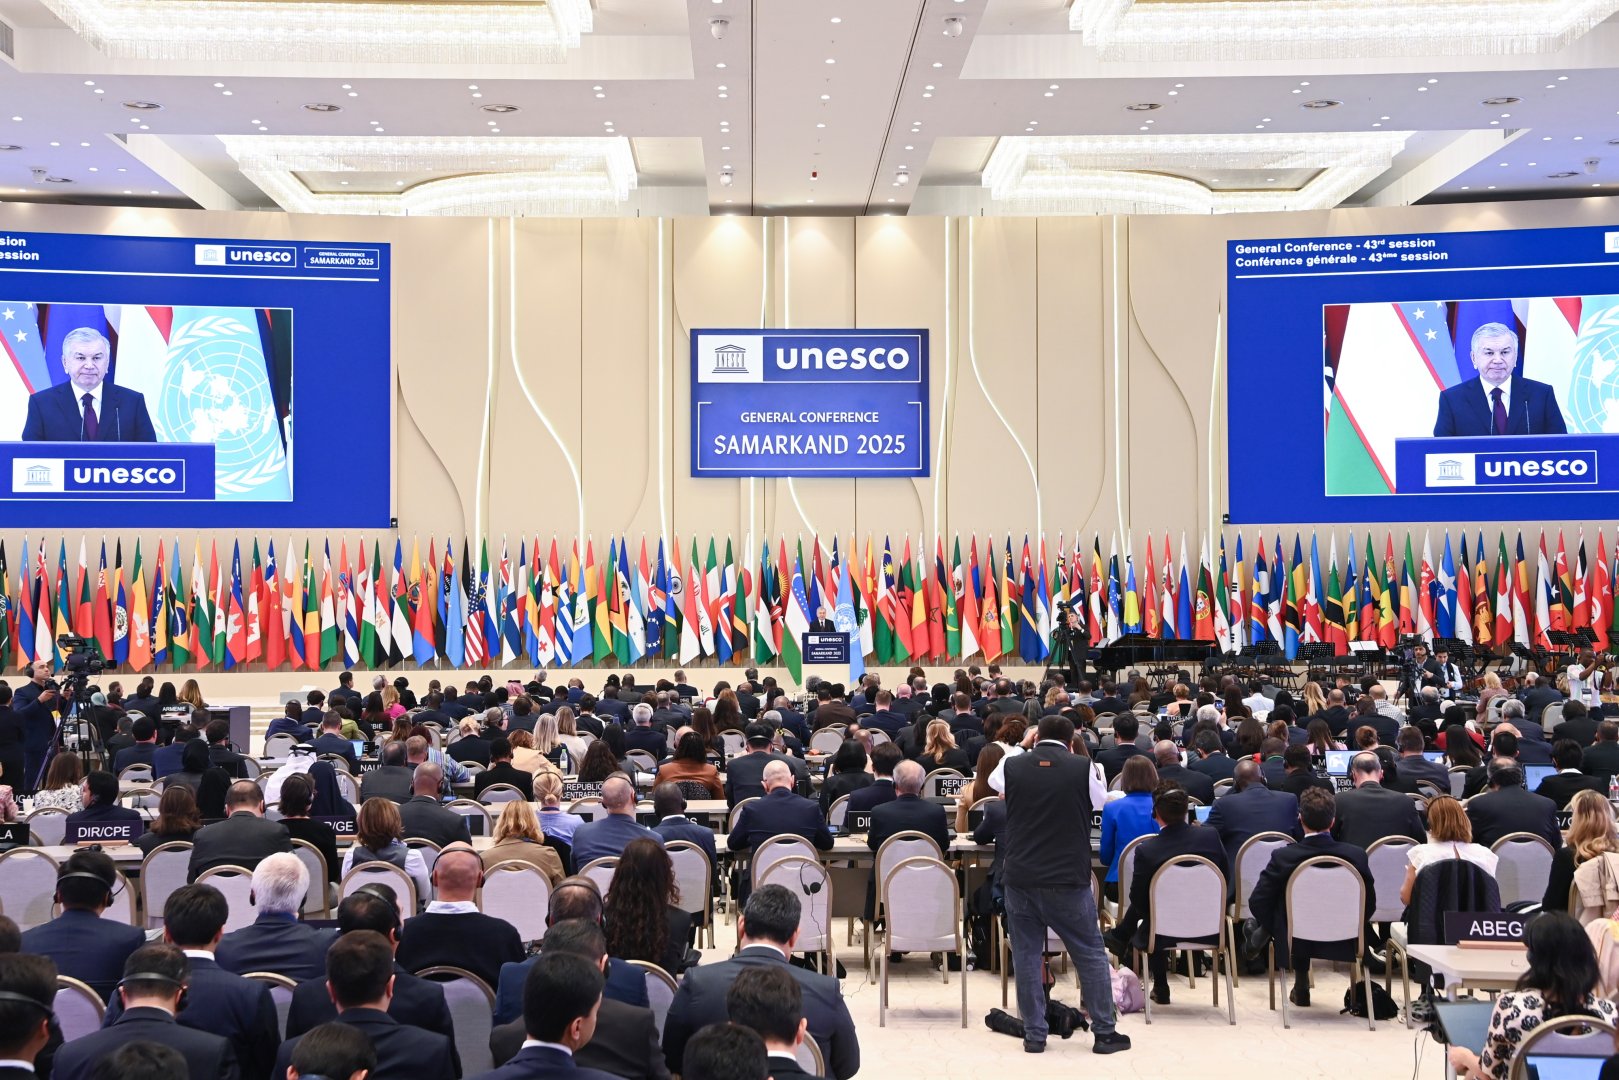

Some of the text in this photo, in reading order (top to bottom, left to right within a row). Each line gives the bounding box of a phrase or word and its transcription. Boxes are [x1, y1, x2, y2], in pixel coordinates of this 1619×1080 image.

[0, 236, 26, 246] sion
[1235, 244, 1281, 254] General
[1284, 242, 1352, 252] Conference
[1363, 239, 1386, 249] 43rd
[1388, 238, 1436, 249] session
[0, 250, 40, 260] ession
[230, 250, 292, 262] unesco
[310, 256, 374, 266] SAMARKAND 2025
[1235, 257, 1303, 267] Conférence
[1306, 254, 1358, 266] générale
[1400, 251, 1448, 261] session
[776, 347, 910, 370] unesco
[740, 412, 879, 423] GENERAL CONFERENCE
[714, 434, 906, 455] SAMARKAND 2025
[74, 467, 176, 484] unesco
[1484, 460, 1588, 477] unesco
[78, 826, 130, 838] DIR/CPE
[1469, 920, 1524, 937] ABEG
